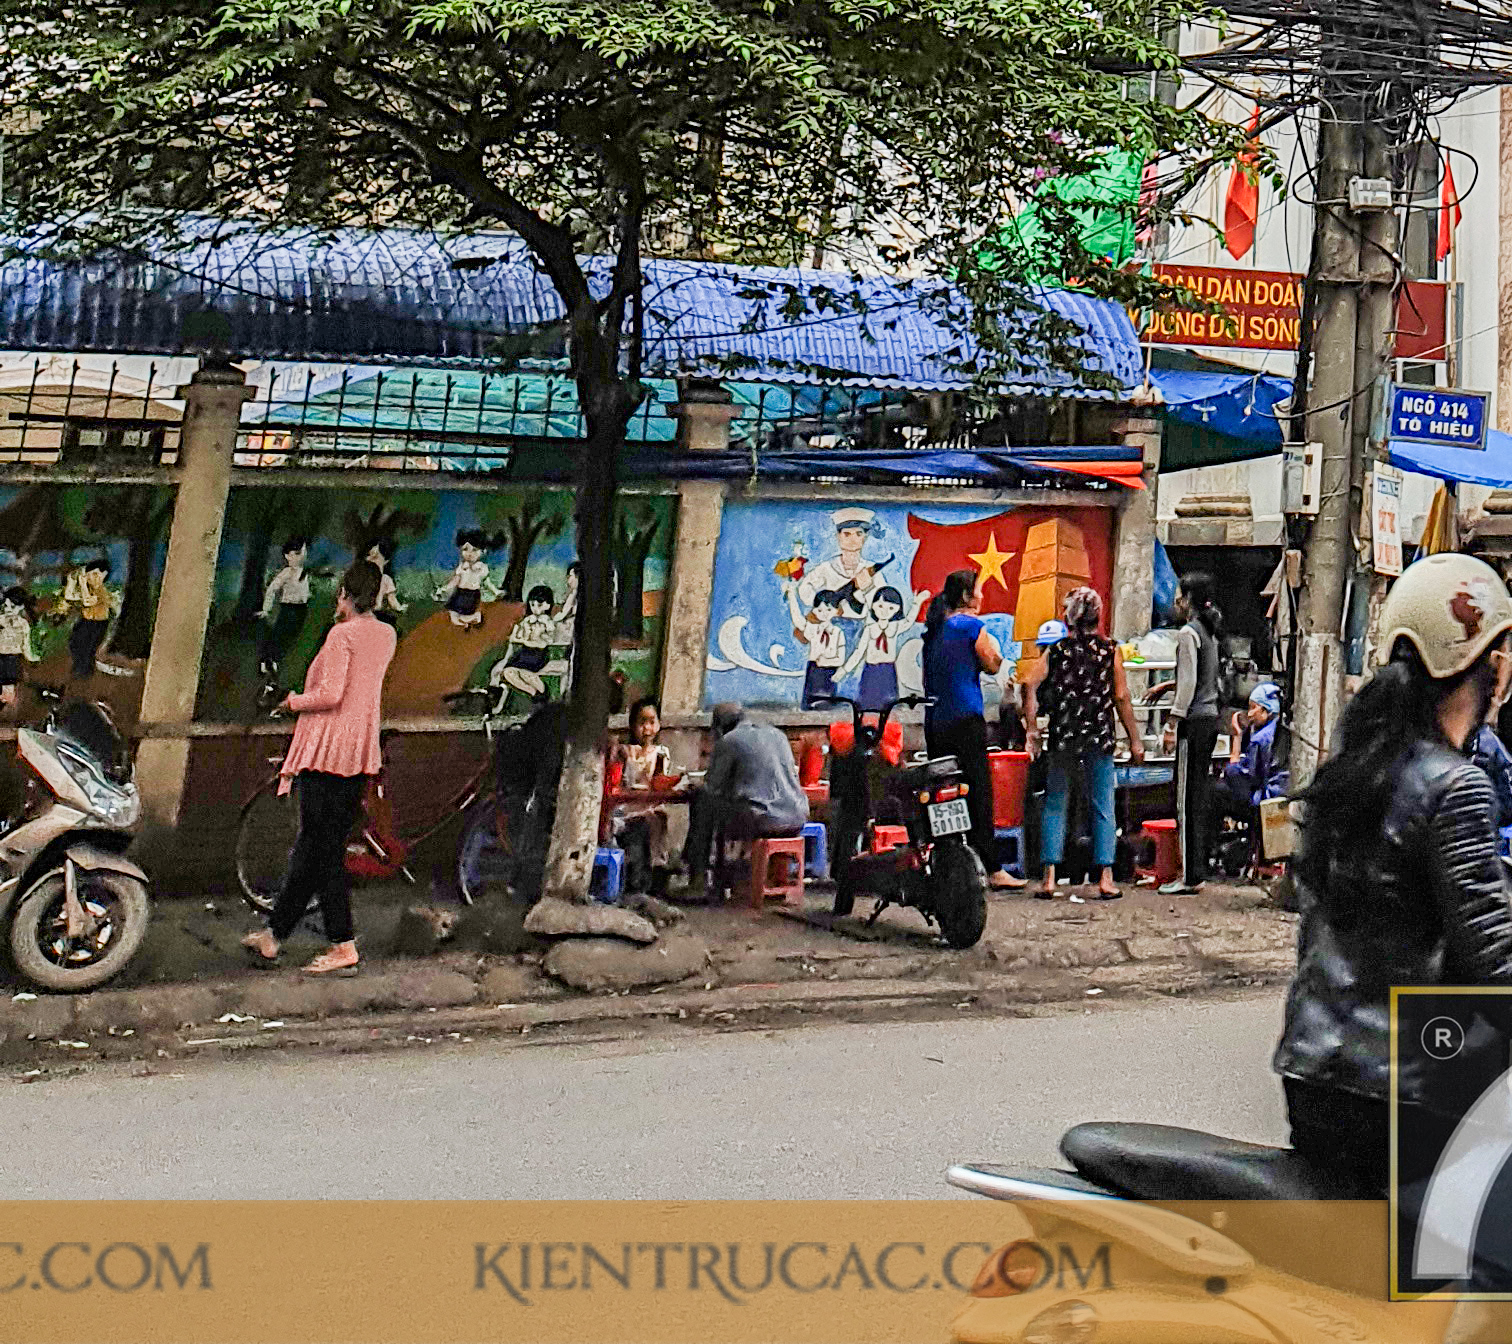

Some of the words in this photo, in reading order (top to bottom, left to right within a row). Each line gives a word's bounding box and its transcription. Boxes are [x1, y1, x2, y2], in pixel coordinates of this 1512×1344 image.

[1401, 394, 1436, 416] NGÕ
[1439, 401, 1469, 419] 414
[1429, 419, 1474, 438] HIỆU
